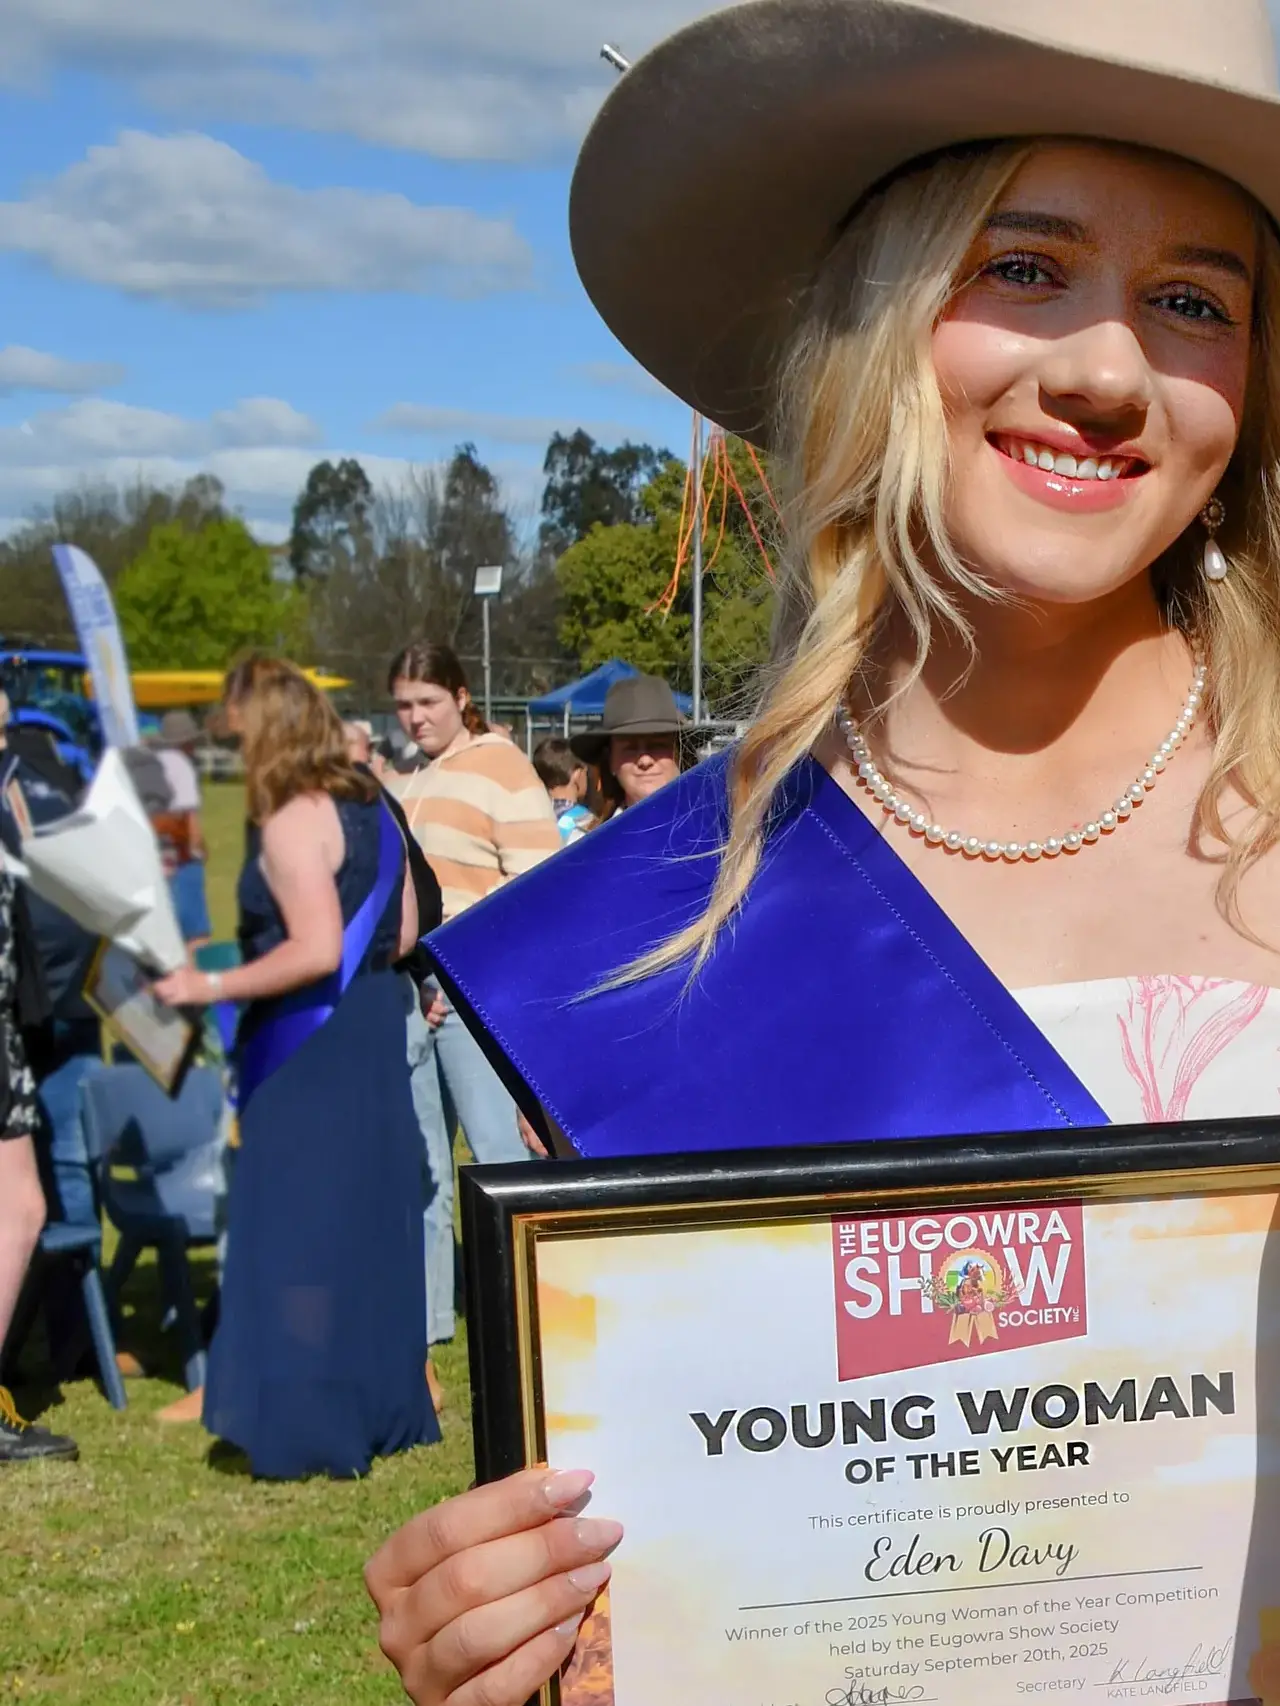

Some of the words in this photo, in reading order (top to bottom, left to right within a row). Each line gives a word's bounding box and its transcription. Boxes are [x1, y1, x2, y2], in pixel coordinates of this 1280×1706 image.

[839, 1223, 856, 1256] THE
[860, 1210, 1071, 1255] EUGOWRA
[998, 1306, 1073, 1327] SOCIETY
[689, 1394, 936, 1456] YOUNG
[955, 1371, 1236, 1436] WOMAN
[844, 1456, 896, 1485] OF
[906, 1448, 981, 1480] THE
[989, 1440, 1090, 1473] YEAR
[808, 1515, 844, 1530] This
[847, 1508, 934, 1527] certificate
[938, 1505, 951, 1520] is
[956, 1499, 1021, 1521] proudly
[1025, 1491, 1109, 1514] presented
[1113, 1491, 1130, 1504] to
[864, 1533, 963, 1582] Eden
[977, 1527, 1079, 1576] Davy
[725, 1626, 789, 1642] Winner
[793, 1621, 810, 1636] of
[815, 1619, 843, 1634] the
[848, 1614, 888, 1631] 2025
[892, 1611, 946, 1627] Young
[951, 1604, 1018, 1621] Woman
[1023, 1600, 1039, 1615] of
[1044, 1598, 1071, 1613] the
[1075, 1595, 1110, 1609] Year
[1115, 1585, 1219, 1606] Competition
[829, 1641, 866, 1656] held
[871, 1638, 892, 1655] by
[896, 1635, 925, 1650] the
[930, 1630, 1004, 1648] Eugowra
[1009, 1623, 1055, 1640] Show
[1059, 1618, 1120, 1636] Society
[844, 1660, 920, 1680] Saturday
[924, 1652, 1018, 1674] September
[1023, 1647, 1065, 1663] 20th,
[1069, 1642, 1109, 1659] 2025
[1016, 1676, 1087, 1693] Secretary
[1107, 1687, 1137, 1698] KATE
[1140, 1681, 1208, 1696] LANGFIELD
